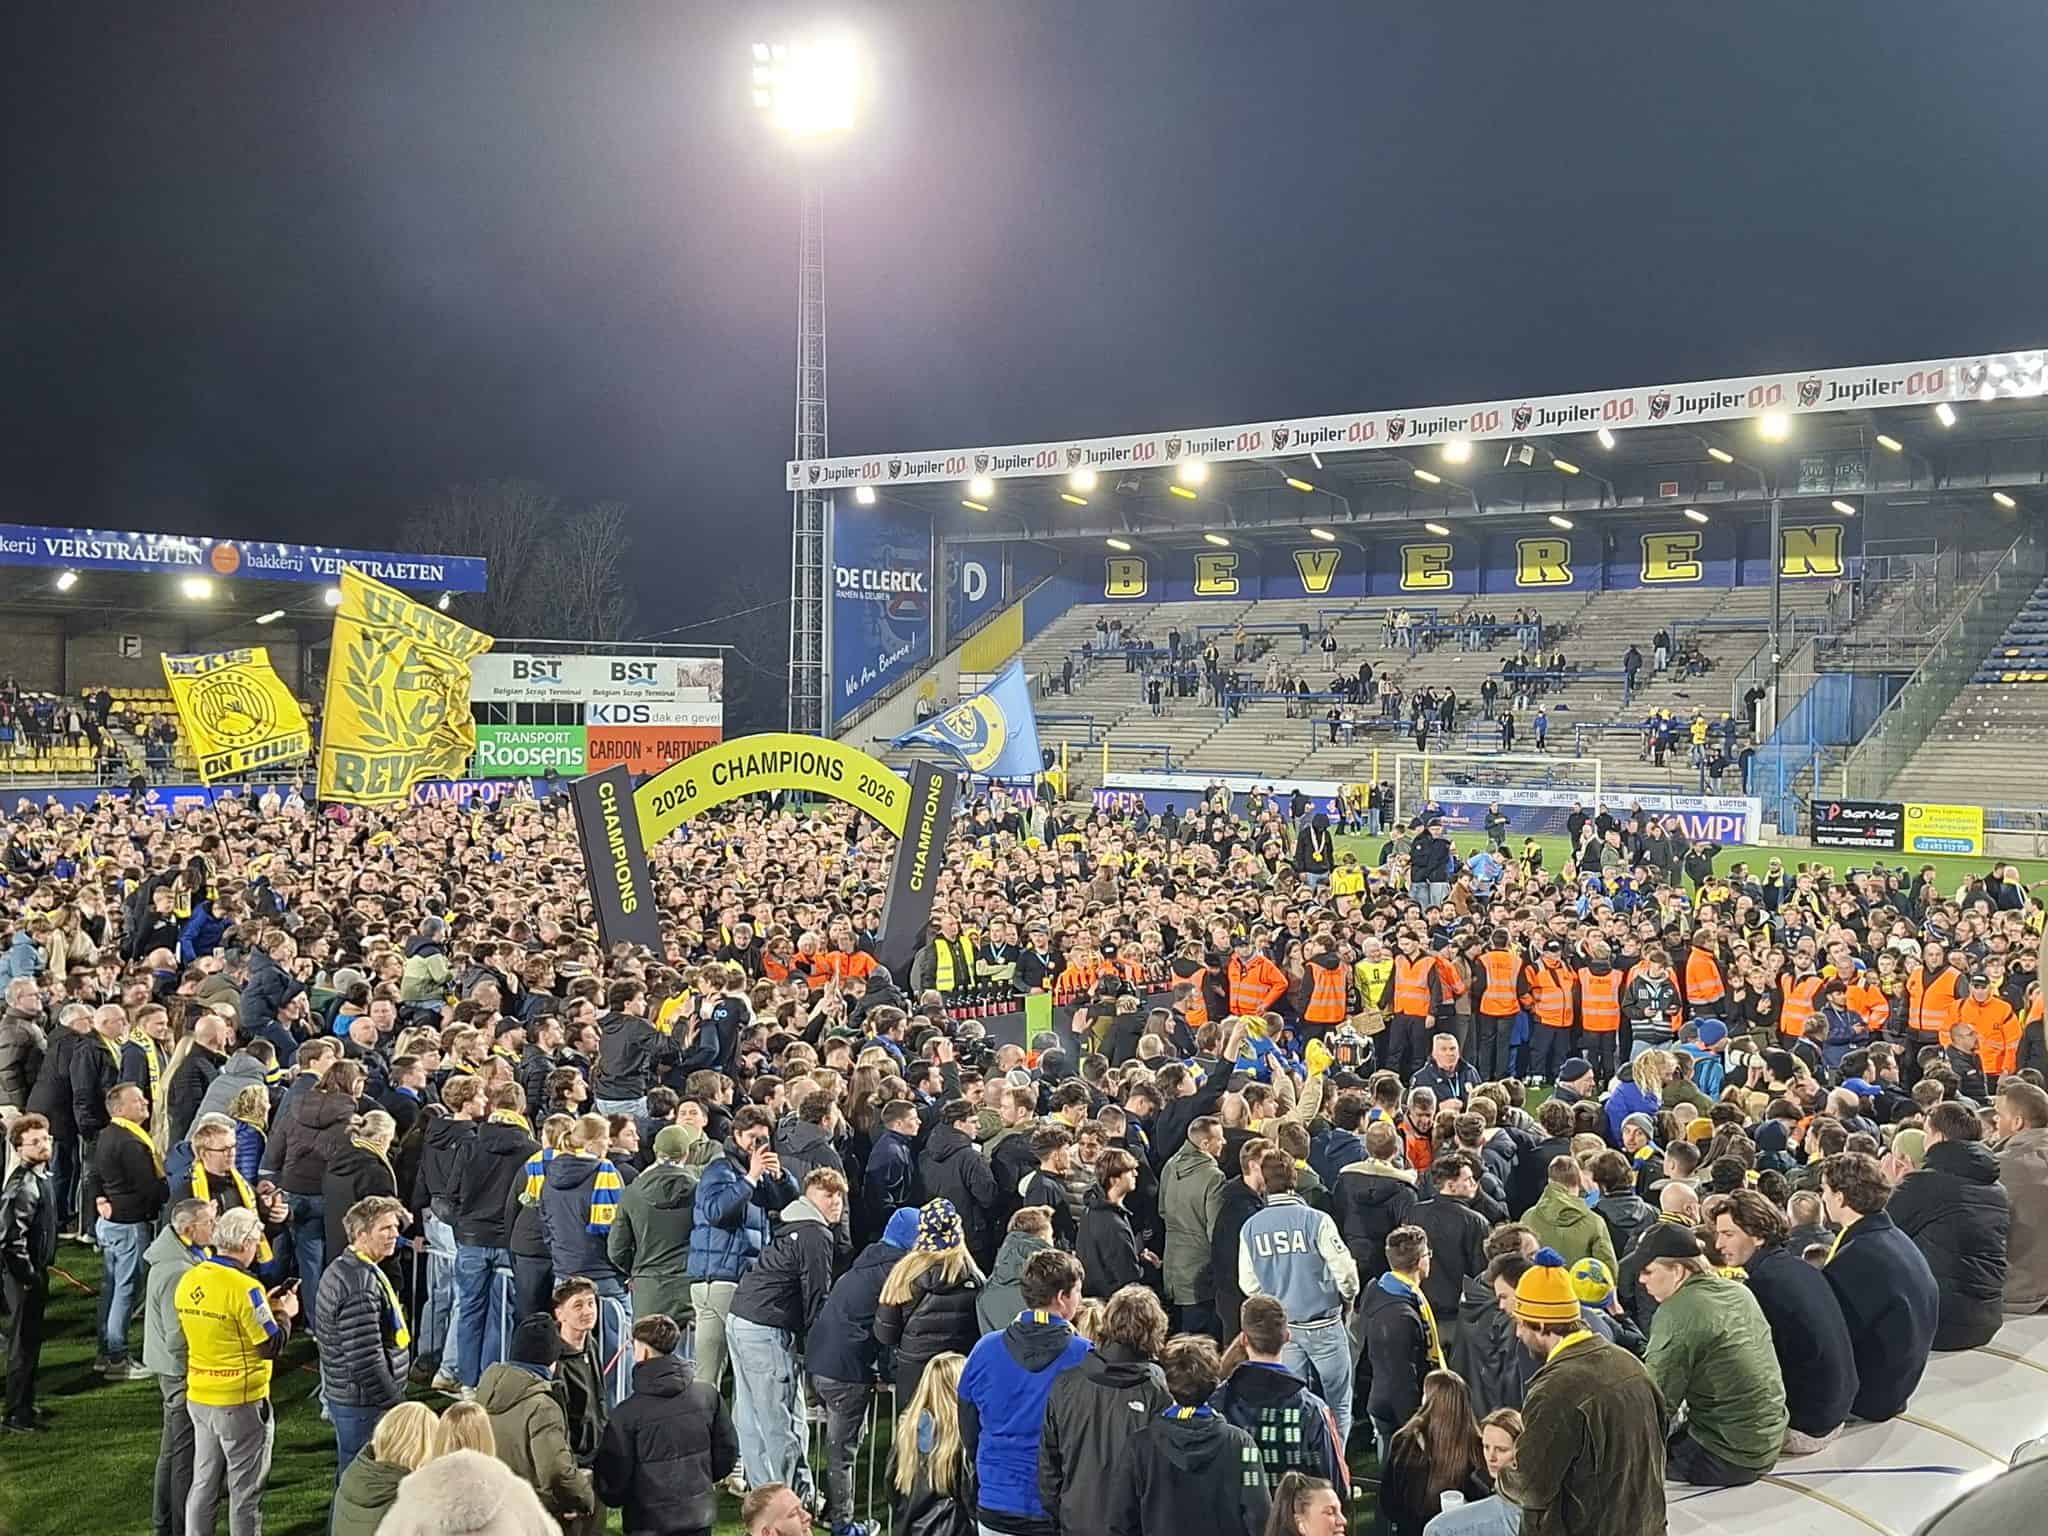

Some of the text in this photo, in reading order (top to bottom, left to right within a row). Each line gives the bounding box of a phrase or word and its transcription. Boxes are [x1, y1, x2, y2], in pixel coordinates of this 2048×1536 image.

[1826, 377, 1904, 403] Jupiler
[1674, 391, 1745, 414] Jupiler
[1535, 404, 1601, 426] Jupiler
[1293, 428, 1347, 447] Jupiler
[1409, 417, 1469, 437] Jupiler
[1086, 446, 1131, 464] Jupiler
[1184, 437, 1235, 456] Jupiler
[822, 466, 861, 481] Jupiler
[904, 461, 945, 476] Jupiler
[992, 455, 1034, 472] Jupiler
[43, 538, 204, 565] VERSTRAETEN
[1105, 523, 1844, 599] BEVEREN
[247, 552, 445, 581] bakkerij VERSTRAETEN
[836, 567, 859, 588] DE
[124, 636, 137, 655] F
[513, 660, 562, 679] BST
[611, 662, 657, 681] BST
[493, 688, 523, 697] Belgian
[526, 688, 547, 697] Scrap
[593, 689, 621, 698] Belgian
[623, 690, 642, 698] Scrap
[593, 704, 720, 725] KDS dak en gevel
[495, 731, 571, 743] TRANSPORT
[204, 754, 233, 776] ON
[239, 735, 305, 766] TOUR
[480, 740, 584, 767] Roosens
[590, 740, 642, 760] CARDON
[711, 750, 845, 786] CHAMPIONS
[651, 778, 698, 818] 2026
[856, 773, 896, 809] 2026
[910, 773, 944, 892] CHAMPIONS
[598, 781, 638, 915] CHAMPIONS
[1255, 1229, 1307, 1257] USA
